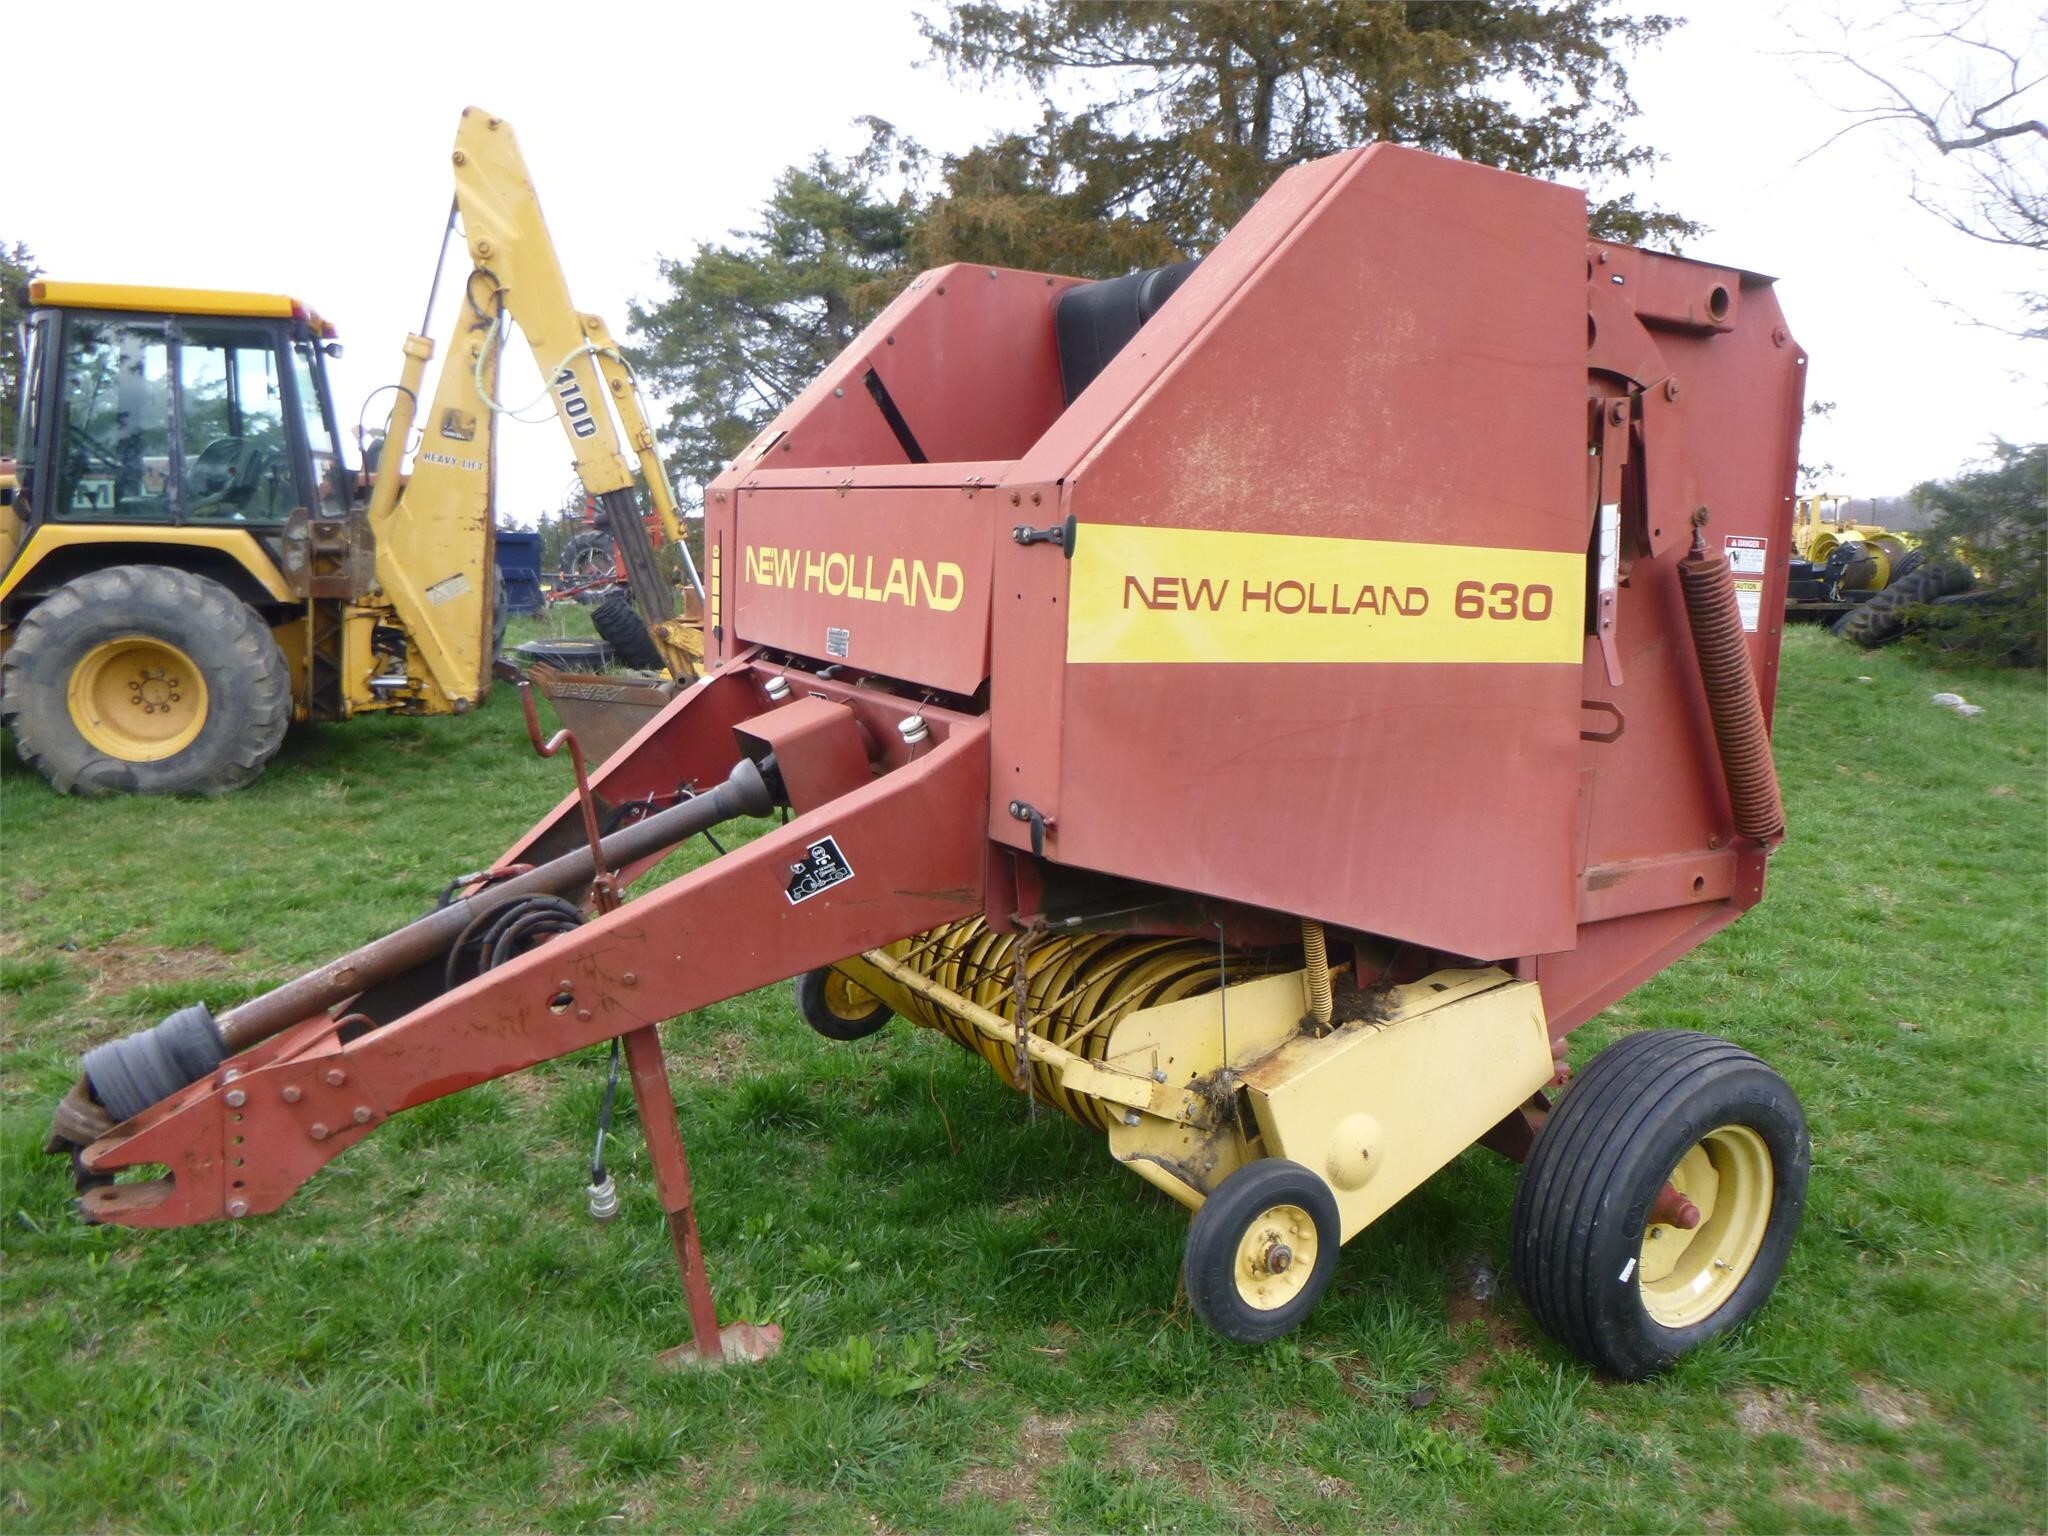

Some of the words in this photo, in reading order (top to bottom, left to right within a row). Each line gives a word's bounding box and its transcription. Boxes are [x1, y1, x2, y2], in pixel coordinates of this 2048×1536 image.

[423, 452, 457, 466] HEAVY
[462, 458, 483, 471] LIFT
[745, 545, 800, 590] NEW
[804, 550, 964, 612] HOLLAND
[1123, 575, 1229, 611] NEW
[1242, 579, 1429, 617] HOLLAND
[1454, 580, 1554, 622] 630
